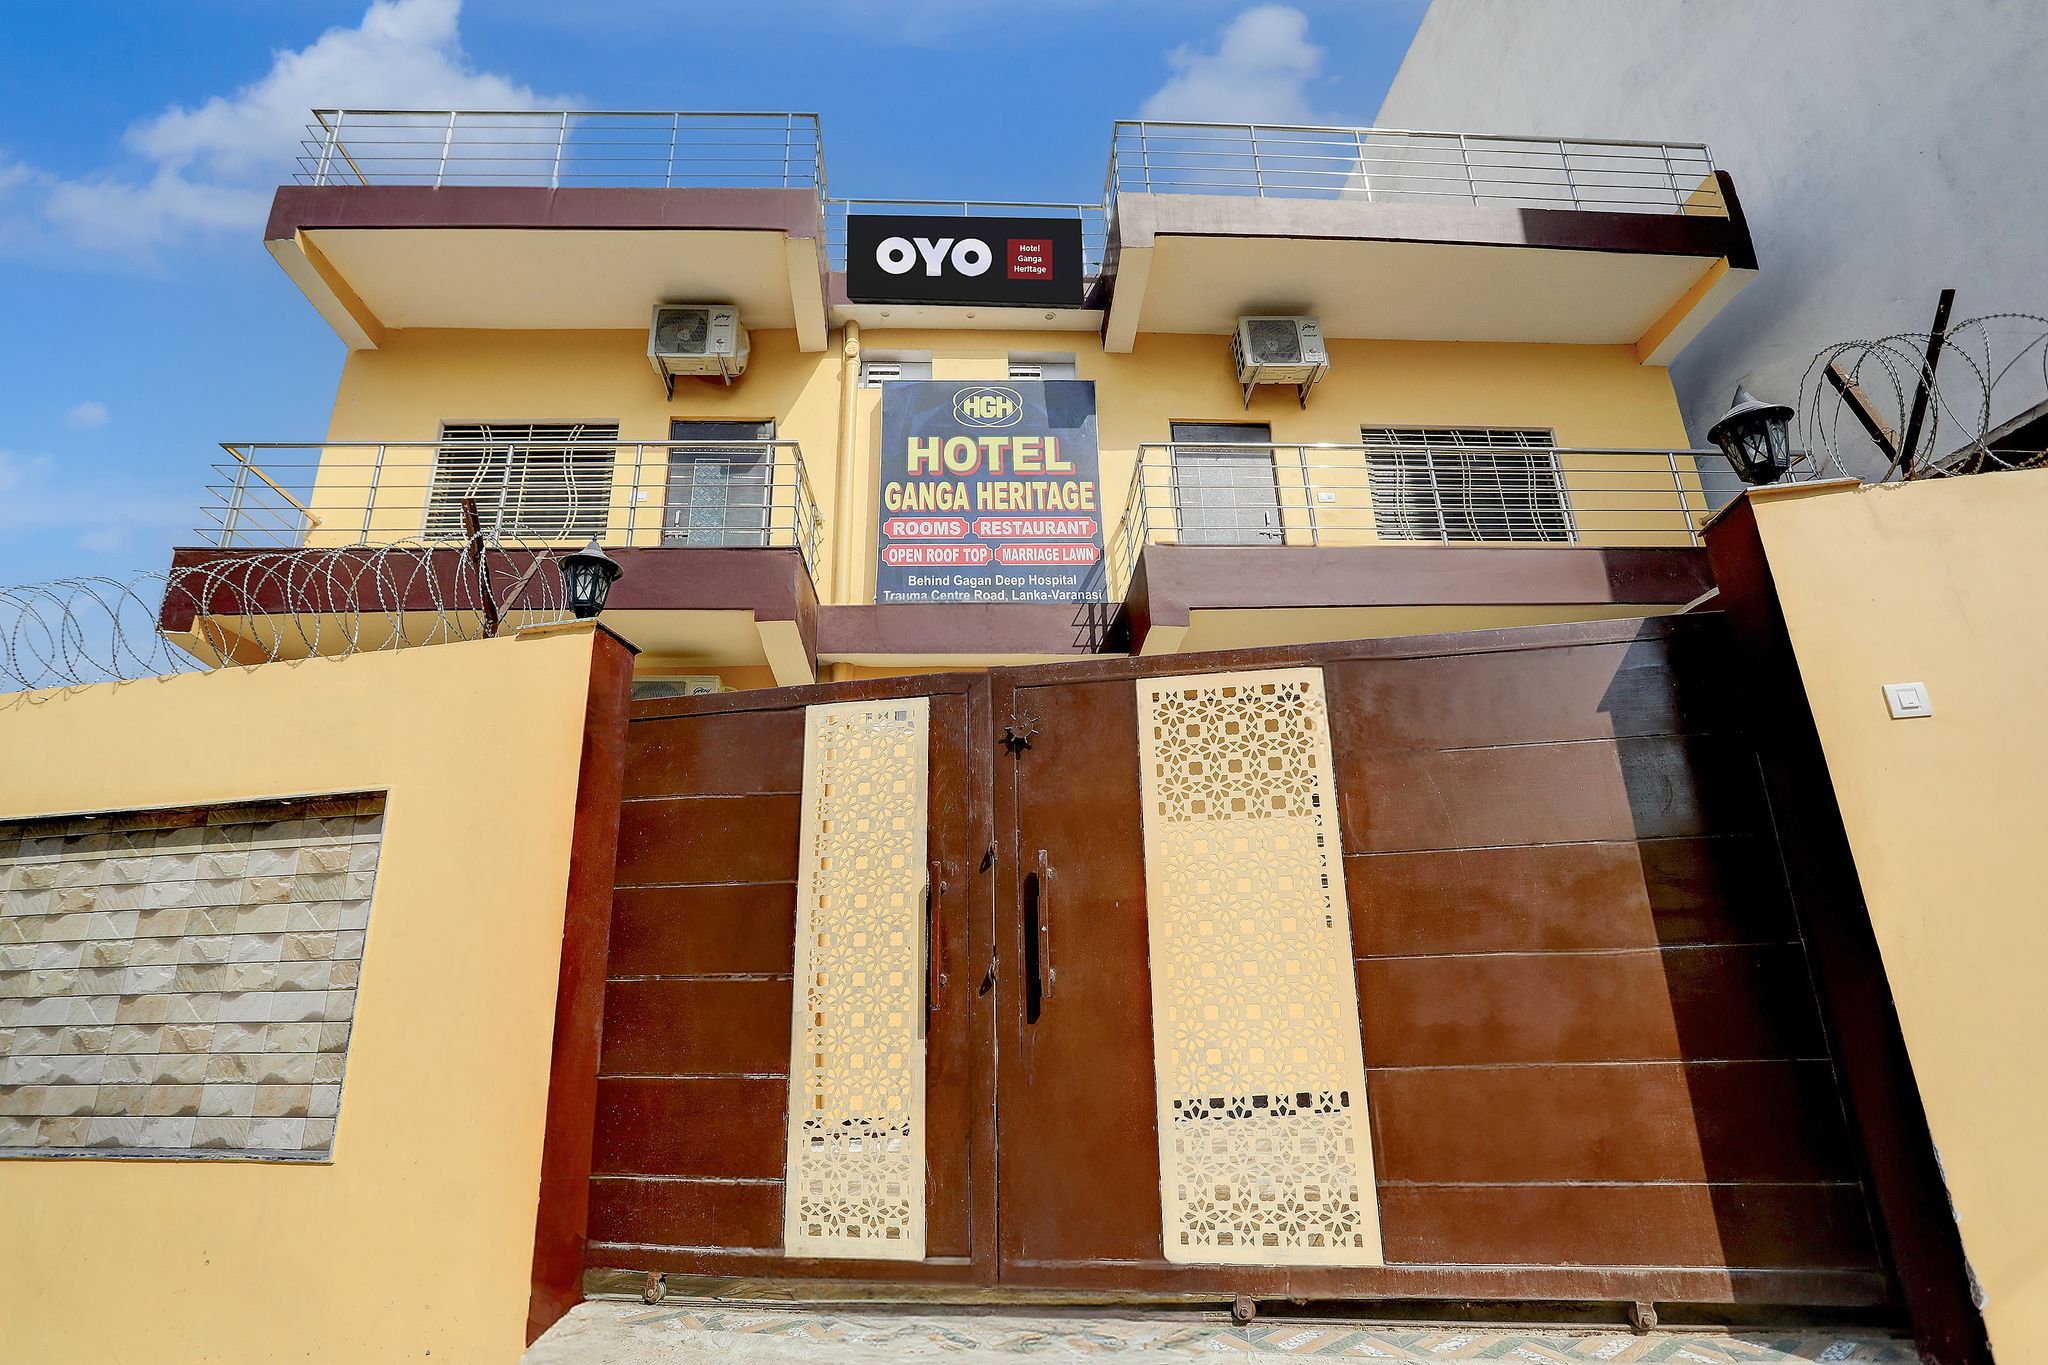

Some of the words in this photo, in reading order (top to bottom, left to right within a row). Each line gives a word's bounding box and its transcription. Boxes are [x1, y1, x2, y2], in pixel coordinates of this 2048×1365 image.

[1019, 244, 1041, 252] Hotel
[876, 237, 992, 277] OYO
[1017, 254, 1043, 264] Ganga
[1013, 265, 1047, 275] Heritage
[963, 395, 1013, 419] HGH
[907, 436, 1076, 476] HOTEL
[884, 481, 972, 513] GANGA
[976, 481, 1097, 513] HERITAGE
[892, 522, 962, 536] ROOMS
[980, 520, 1090, 536] RESTAURANT
[888, 548, 923, 563] OPEN
[926, 548, 959, 562] ROOF
[962, 547, 988, 562] TOP
[1002, 547, 1060, 562] MARRIAGE
[1062, 546, 1094, 561] LAWN
[908, 575, 950, 587] Behind
[953, 575, 992, 588] Gagan
[995, 575, 1025, 588] Deep
[1028, 574, 1077, 588] Hospital
[883, 590, 928, 601] Trauma
[931, 590, 971, 601] Centre
[974, 589, 1009, 602] Road,
[1012, 588, 1103, 601] Lanka-Varanasi
